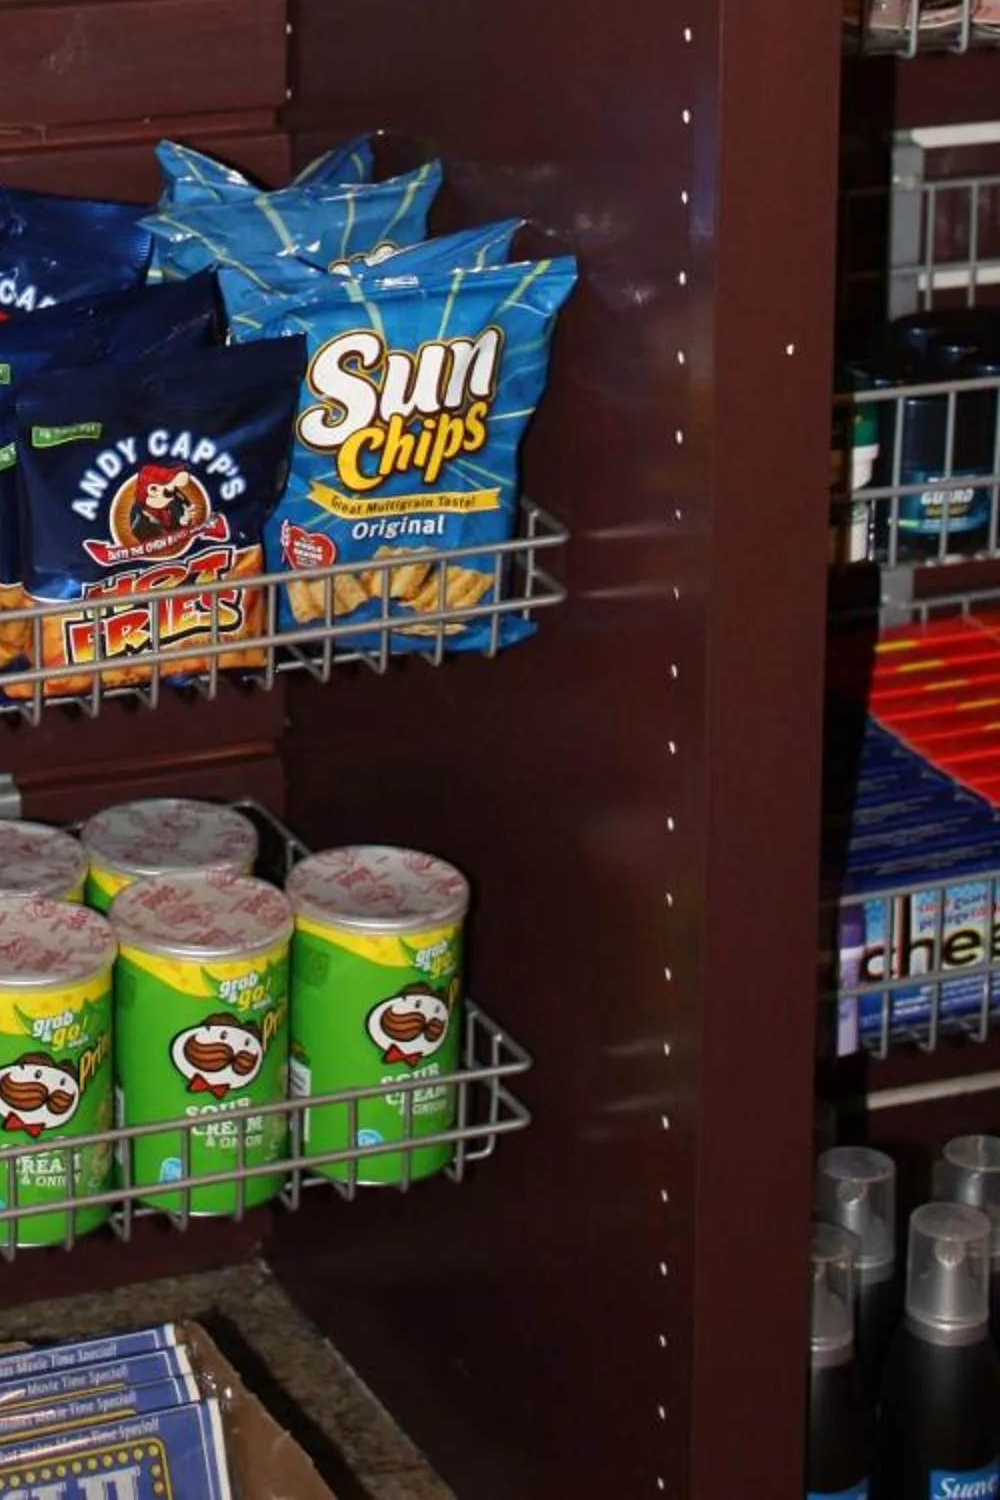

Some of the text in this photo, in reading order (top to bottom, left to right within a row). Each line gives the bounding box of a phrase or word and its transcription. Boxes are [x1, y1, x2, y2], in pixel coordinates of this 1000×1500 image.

[300, 329, 500, 448] Sun
[71, 430, 246, 521] ANDY CAPP'S
[337, 401, 488, 491] Chips
[352, 515, 445, 541] Original
[87, 550, 229, 612] HOT
[70, 594, 240, 664] FRIES
[191, 1114, 264, 1136] CREM
[6, 1153, 80, 1174] REA
